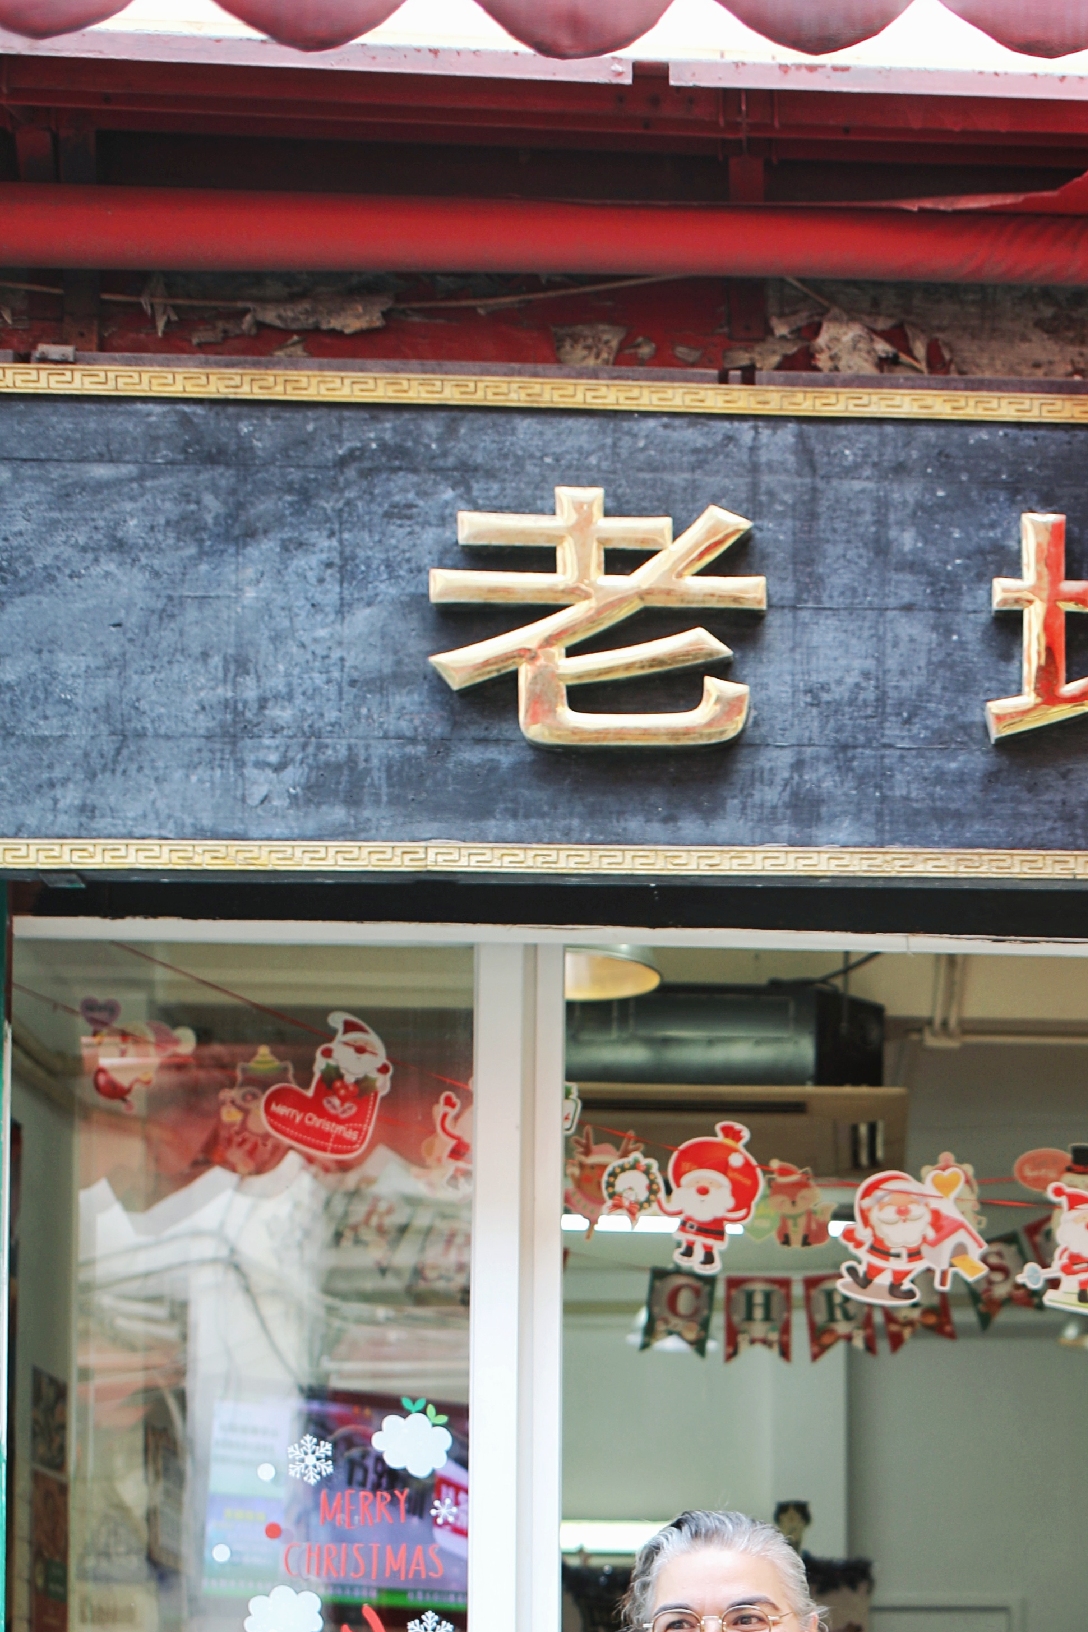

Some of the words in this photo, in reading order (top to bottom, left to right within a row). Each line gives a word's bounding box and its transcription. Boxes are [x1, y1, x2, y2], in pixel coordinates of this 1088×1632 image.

[270, 1101, 304, 1124] Merry
[304, 1112, 359, 1142] Christmas
[319, 1488, 410, 1530] MERRY
[283, 1541, 445, 1581] CHRISTMAS
